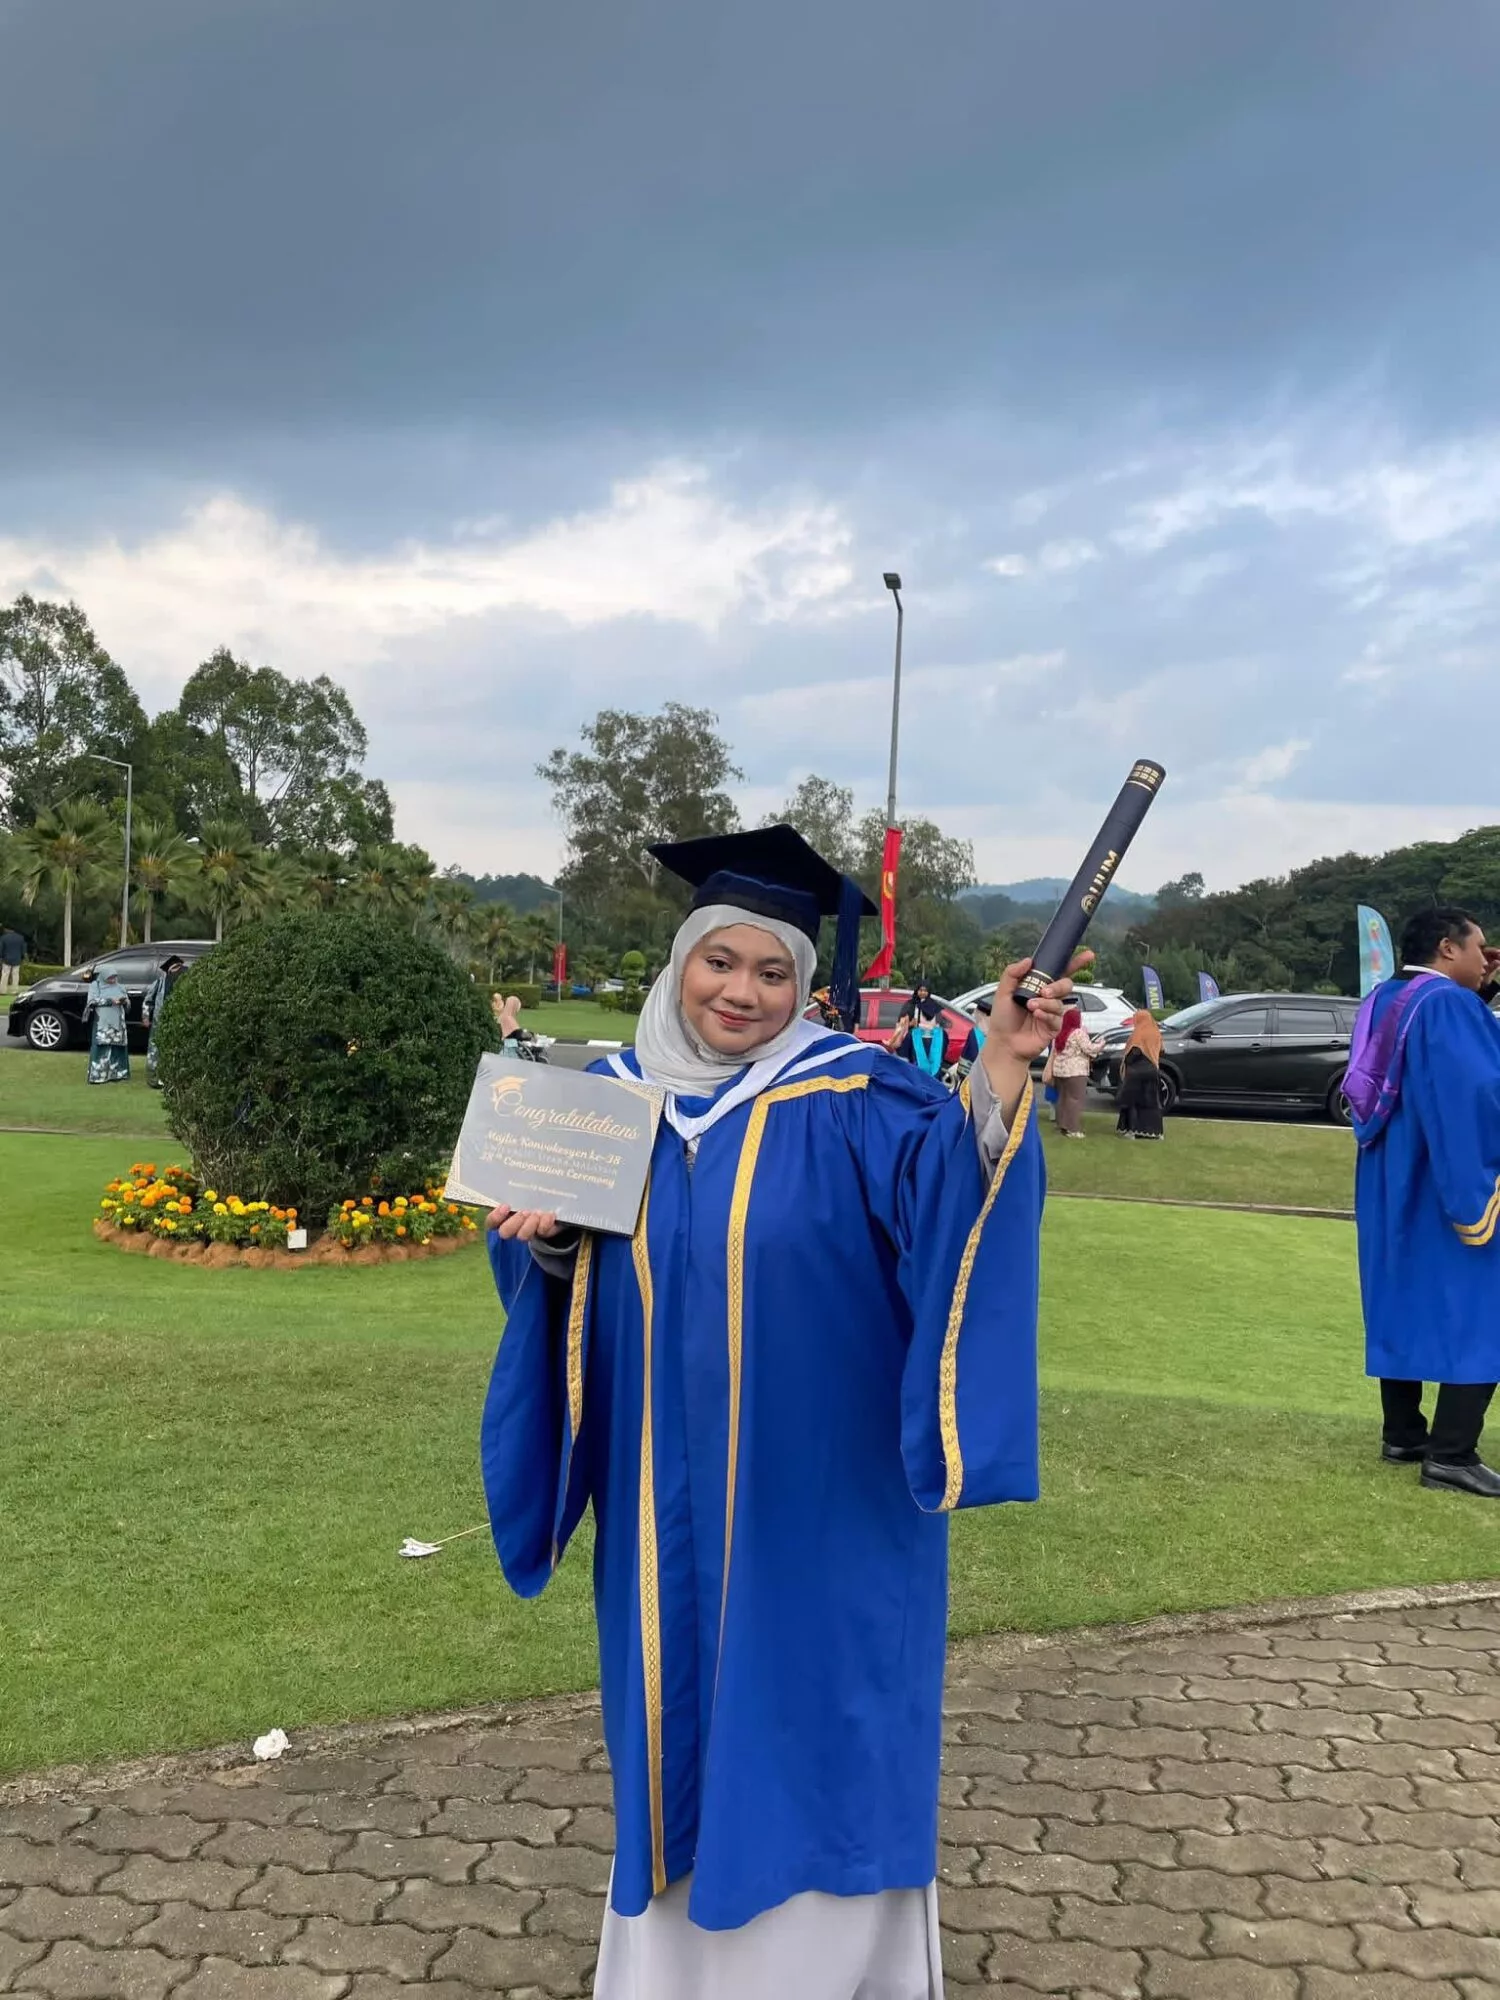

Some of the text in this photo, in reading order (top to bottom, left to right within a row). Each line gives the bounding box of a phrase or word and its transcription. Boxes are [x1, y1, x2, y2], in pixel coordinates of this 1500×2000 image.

[493, 1089, 641, 1140] Congratulations
[503, 1156, 564, 1177] Convocation
[566, 1168, 617, 1190] Ceremony
